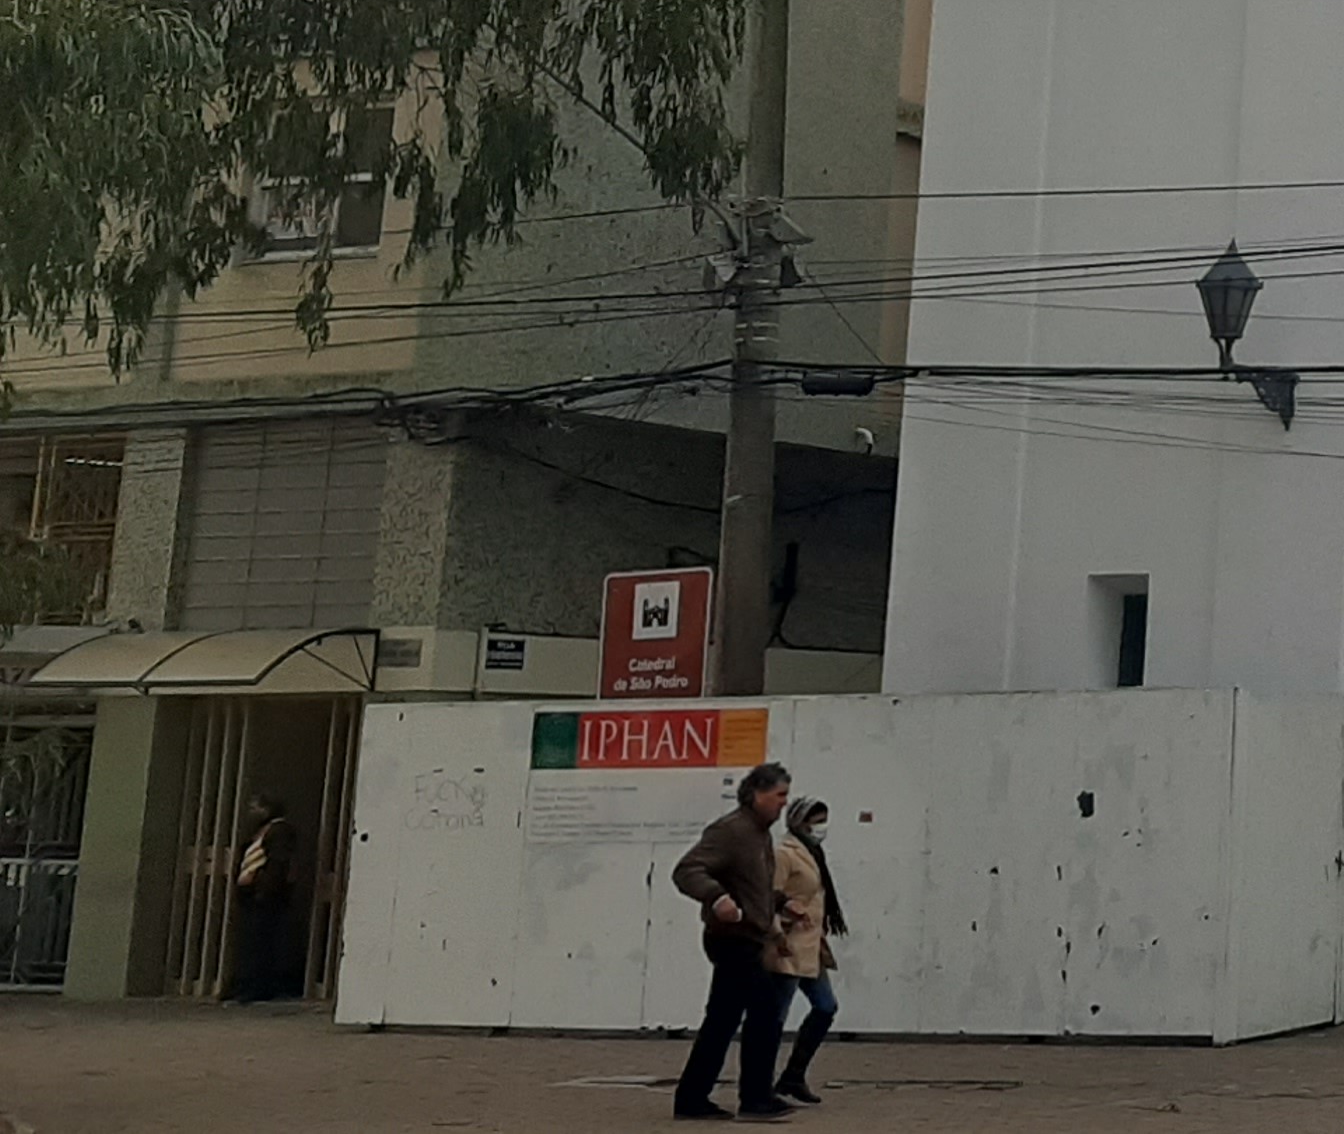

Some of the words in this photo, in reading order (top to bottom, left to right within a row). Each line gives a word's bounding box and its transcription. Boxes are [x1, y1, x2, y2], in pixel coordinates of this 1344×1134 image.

[628, 656, 677, 672] Catedral
[613, 678, 628, 691] de
[629, 676, 652, 690] São
[654, 674, 689, 689] Pedro
[581, 717, 713, 761] IPHAN
